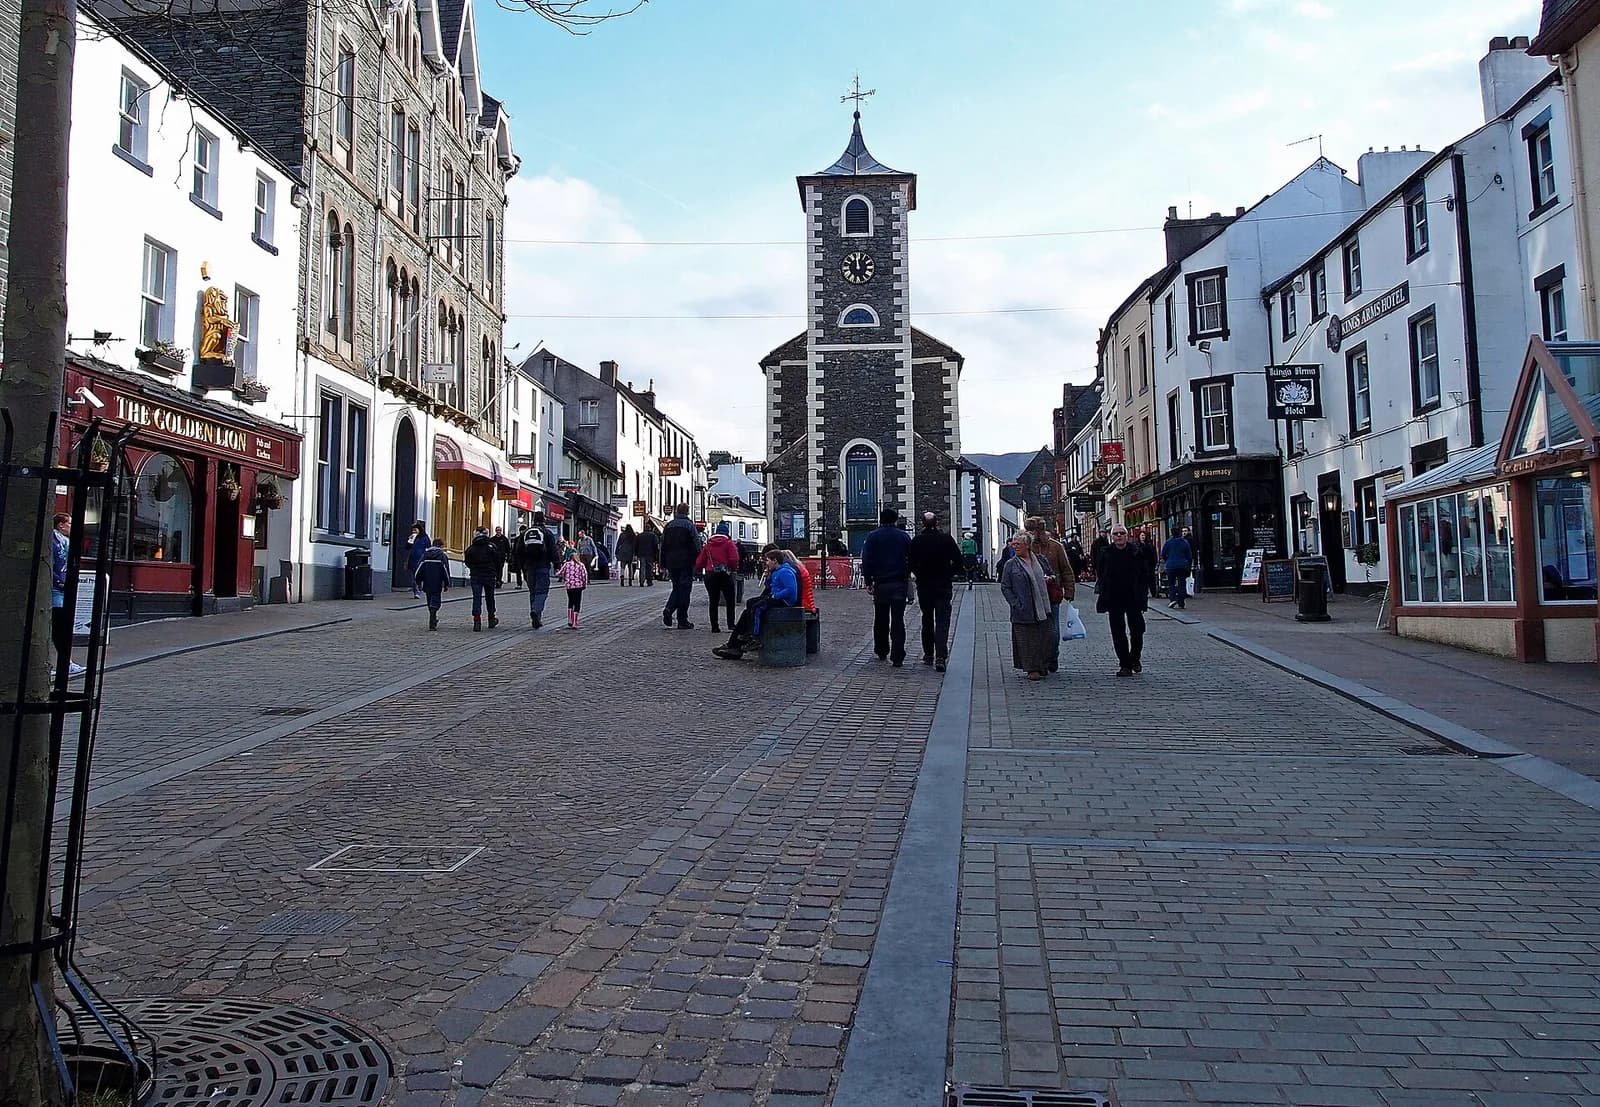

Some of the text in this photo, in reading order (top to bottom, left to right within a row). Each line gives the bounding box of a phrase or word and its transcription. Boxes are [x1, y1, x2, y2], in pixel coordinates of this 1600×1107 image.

[1361, 301, 1381, 325] ARMS
[1381, 288, 1406, 313] HOTEL
[1294, 366, 1316, 376] Arms
[1284, 406, 1306, 415] Hotel
[115, 395, 247, 452] THE GOLDEN LION
[1201, 469, 1232, 477] Pharmacy
